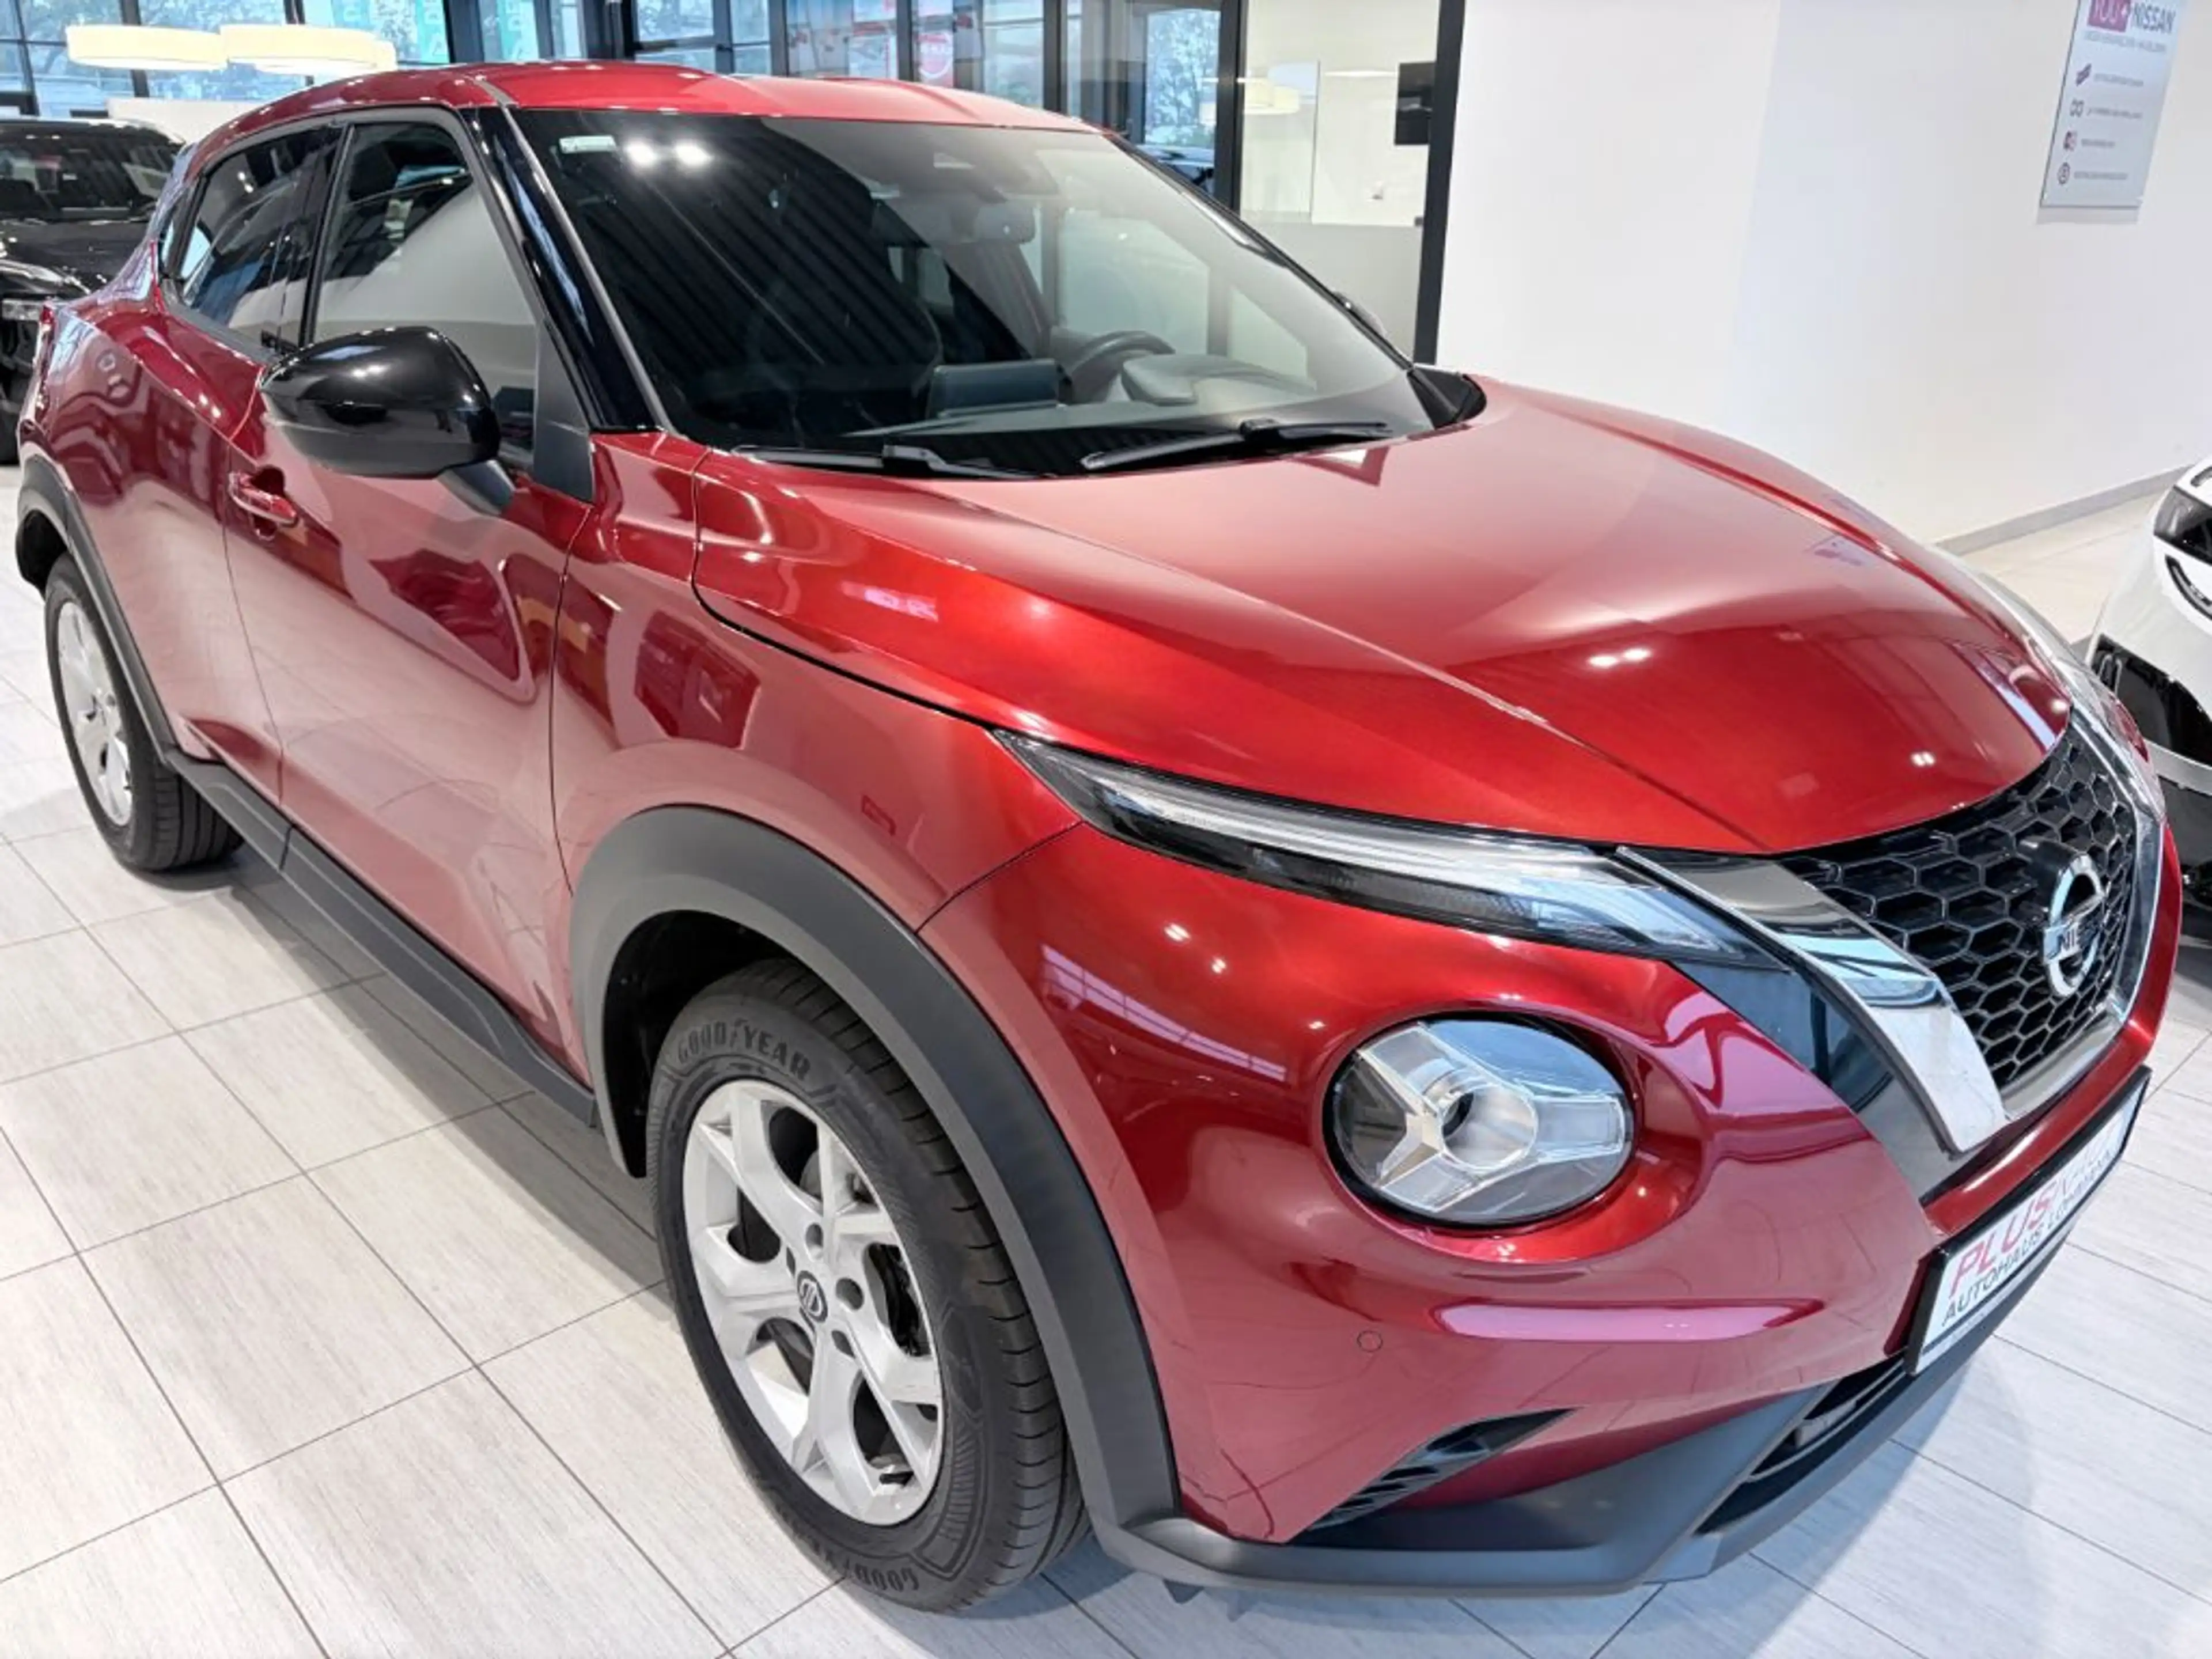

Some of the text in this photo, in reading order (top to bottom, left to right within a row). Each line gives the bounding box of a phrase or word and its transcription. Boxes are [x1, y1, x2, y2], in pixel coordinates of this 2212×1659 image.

[2133, 2, 2176, 33] NISSAN
[1942, 1221, 2046, 1326] AUTOHAUS
[1948, 1180, 2059, 1300] PLUS
